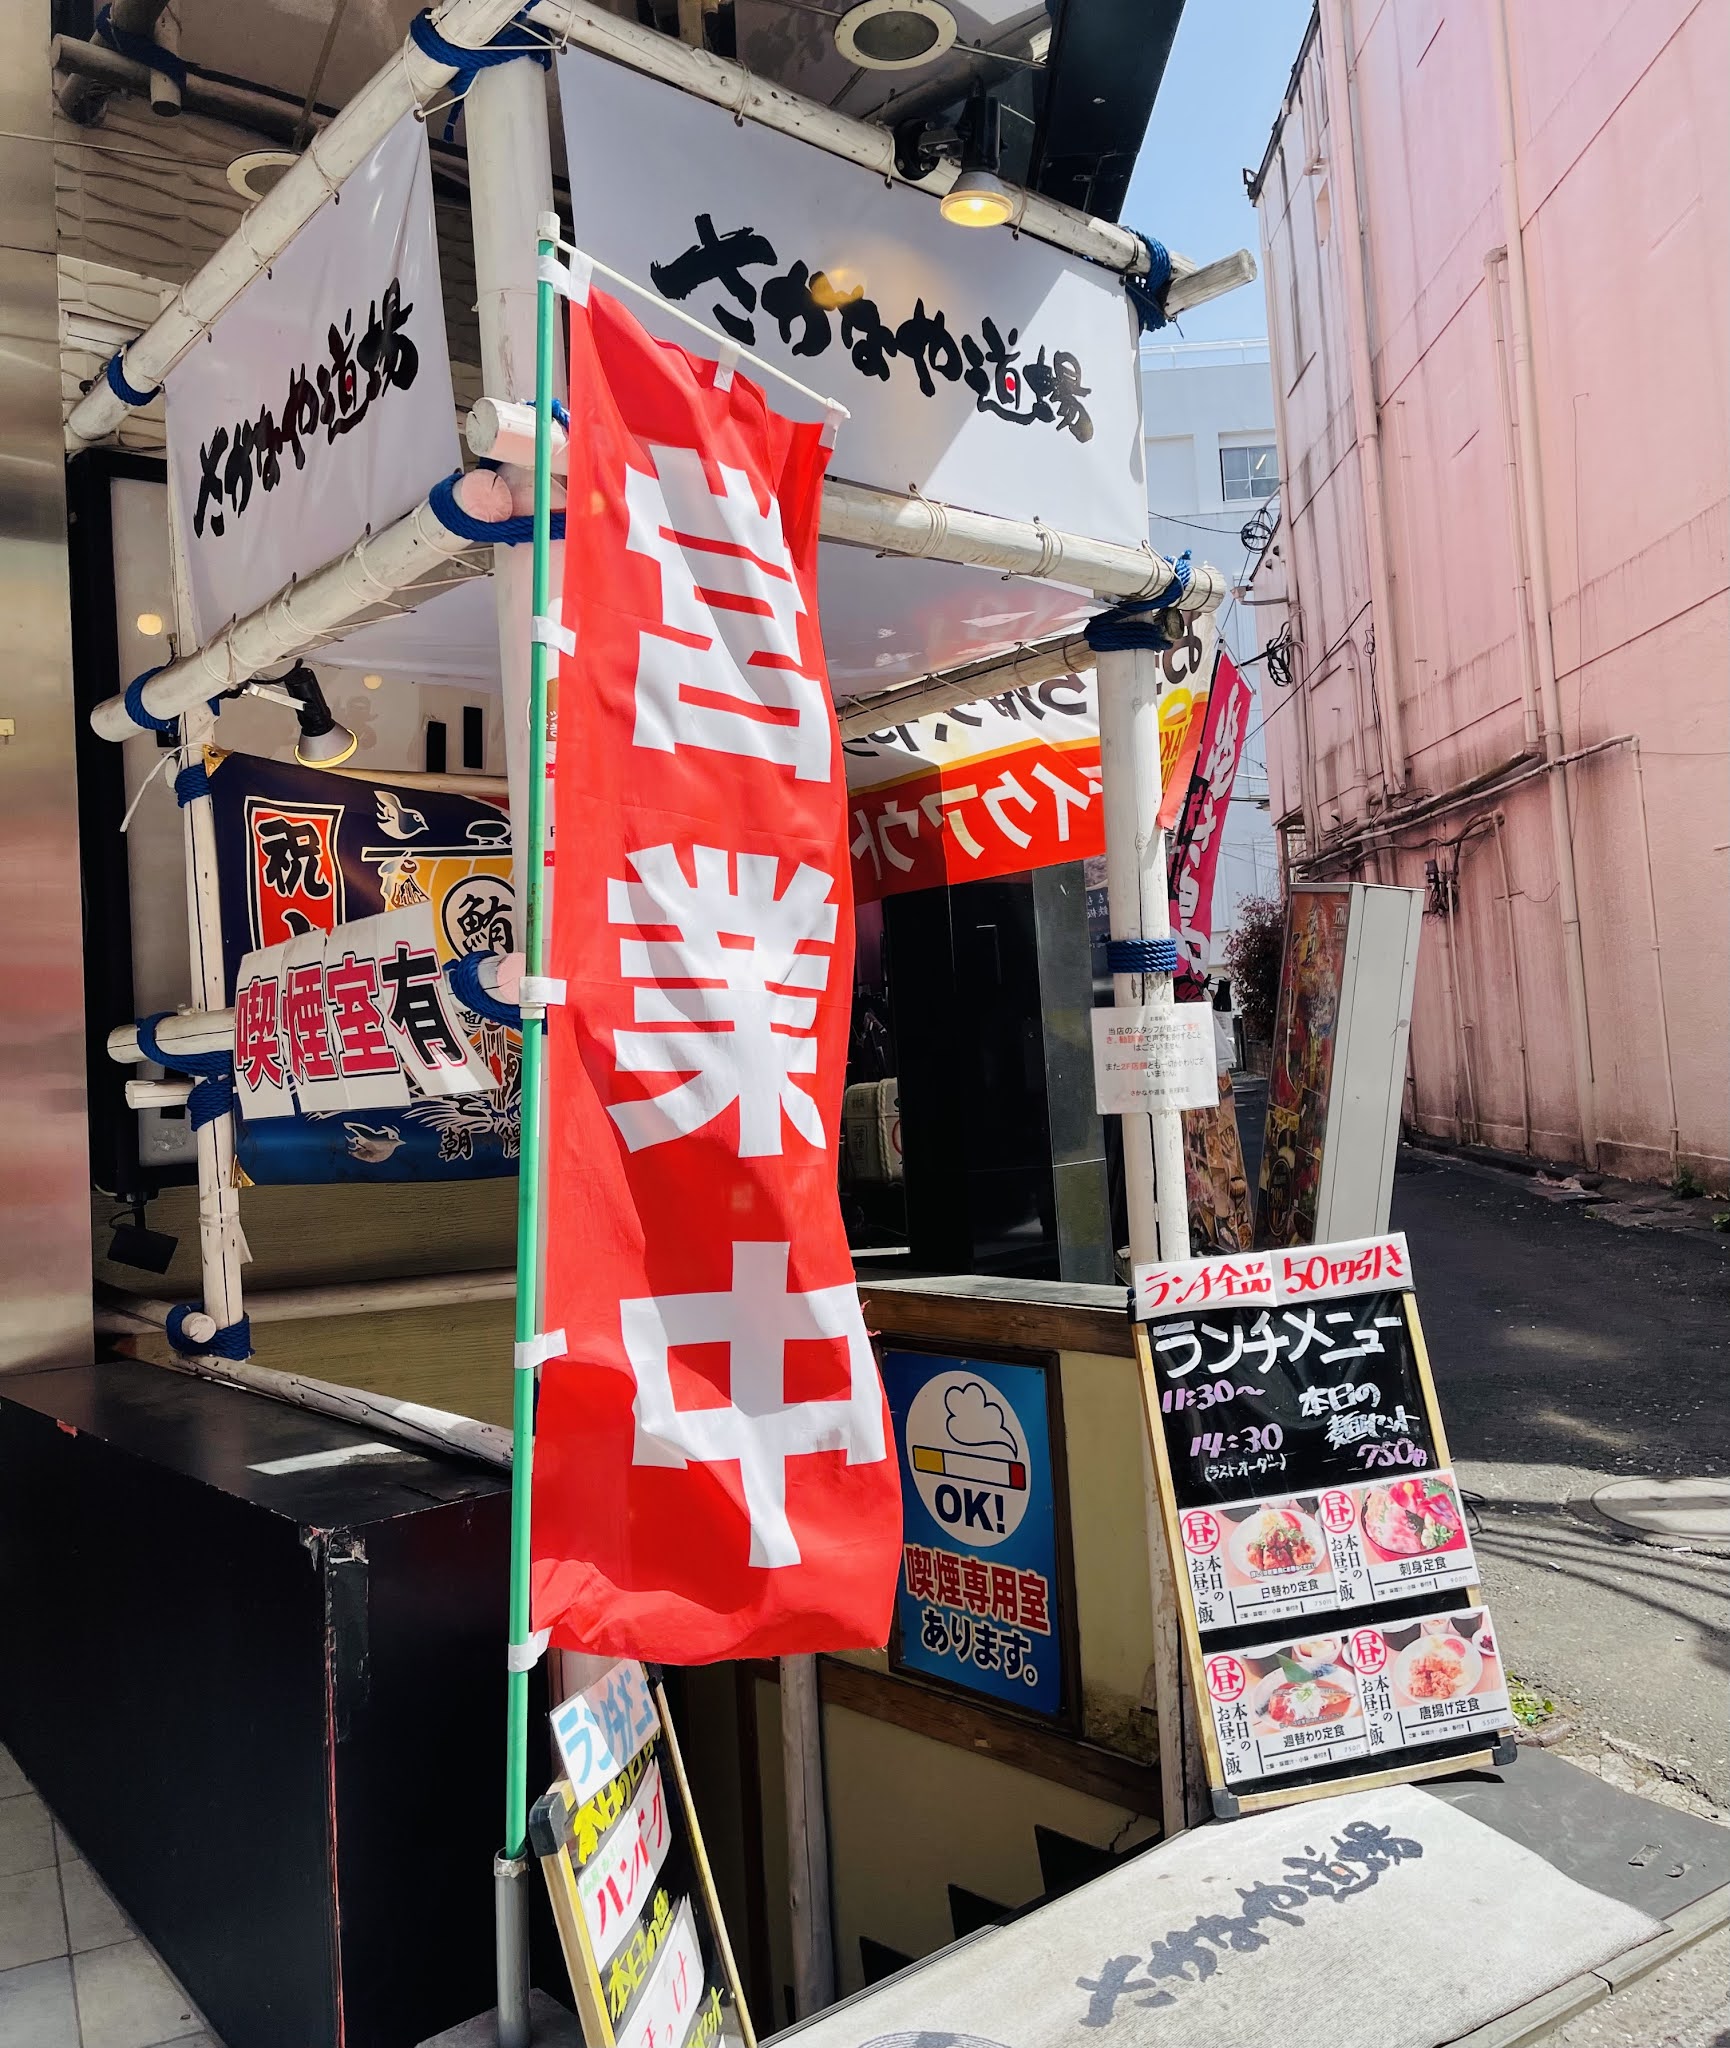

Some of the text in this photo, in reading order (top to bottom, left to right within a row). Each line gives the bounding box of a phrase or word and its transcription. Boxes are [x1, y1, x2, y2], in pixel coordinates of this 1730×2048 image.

[651, 213, 1094, 443] さかなや道場
[193, 277, 419, 538] さかなや道場
[235, 939, 469, 1092] 喫煙室有
[605, 445, 888, 1570] 営業中
[1144, 1244, 1404, 1308] ランチ全品 50円引き
[1152, 1308, 1402, 1378] ランチメニュー
[1299, 1382, 1381, 1417] 本日の
[1190, 1423, 1283, 1458] 14:30
[1356, 1437, 1428, 1469] 750円
[934, 1483, 1006, 1535] OK!
[1206, 1555, 1224, 1601] 本日の
[1331, 1537, 1355, 1601] お昼ご飯
[1343, 1534, 1362, 1579] 本日の
[1399, 1556, 1447, 1576] 刺身定食
[904, 1543, 1051, 1636] 喫煙専用室
[1191, 1558, 1215, 1624] お昼ご飯
[1261, 1579, 1319, 1599] 日替わり定食
[921, 1607, 1038, 1687] あります。
[1232, 1702, 1251, 1751] 本日の
[1361, 1679, 1384, 1746] お昼ご飯
[1374, 1675, 1392, 1722] 本日の
[1419, 1698, 1480, 1720] 唐揚げ定食
[1217, 1706, 1242, 1776] お昼ご飯
[1283, 1725, 1345, 1748] 週替わり定食
[1076, 1821, 1424, 2027] さかなや道場
